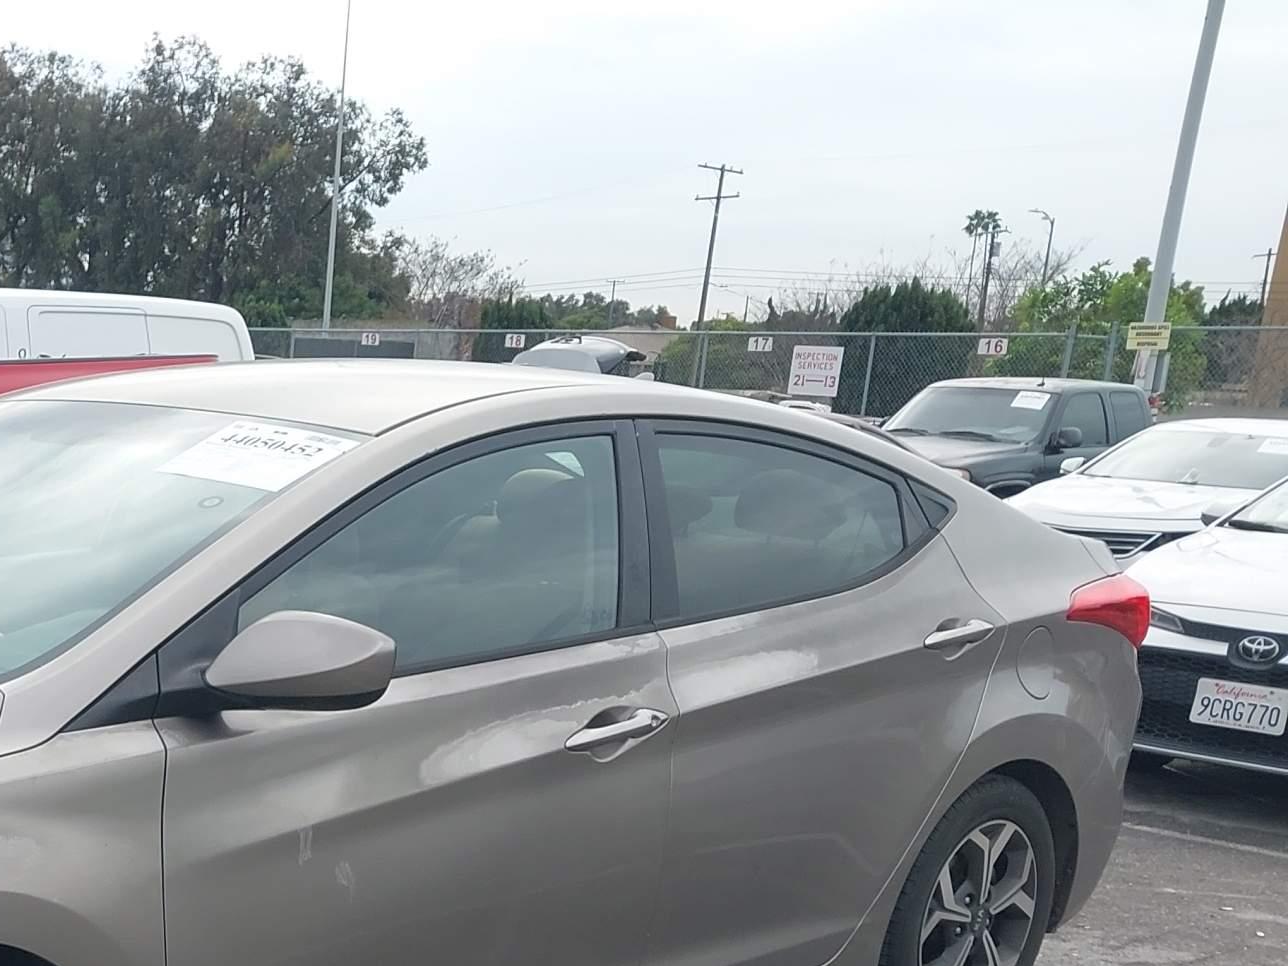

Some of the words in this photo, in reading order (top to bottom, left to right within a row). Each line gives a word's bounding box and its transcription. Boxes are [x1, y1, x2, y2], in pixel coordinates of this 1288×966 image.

[365, 333, 377, 345] 19
[509, 335, 523, 347] 18
[752, 338, 770, 350] 17
[984, 340, 1003, 353] 16
[795, 351, 839, 362] INSPECTION
[797, 361, 834, 371] SERVICES
[221, 434, 324, 456] 44050452
[1216, 685, 1268, 699] California
[1197, 696, 1281, 727] 9CRG770
